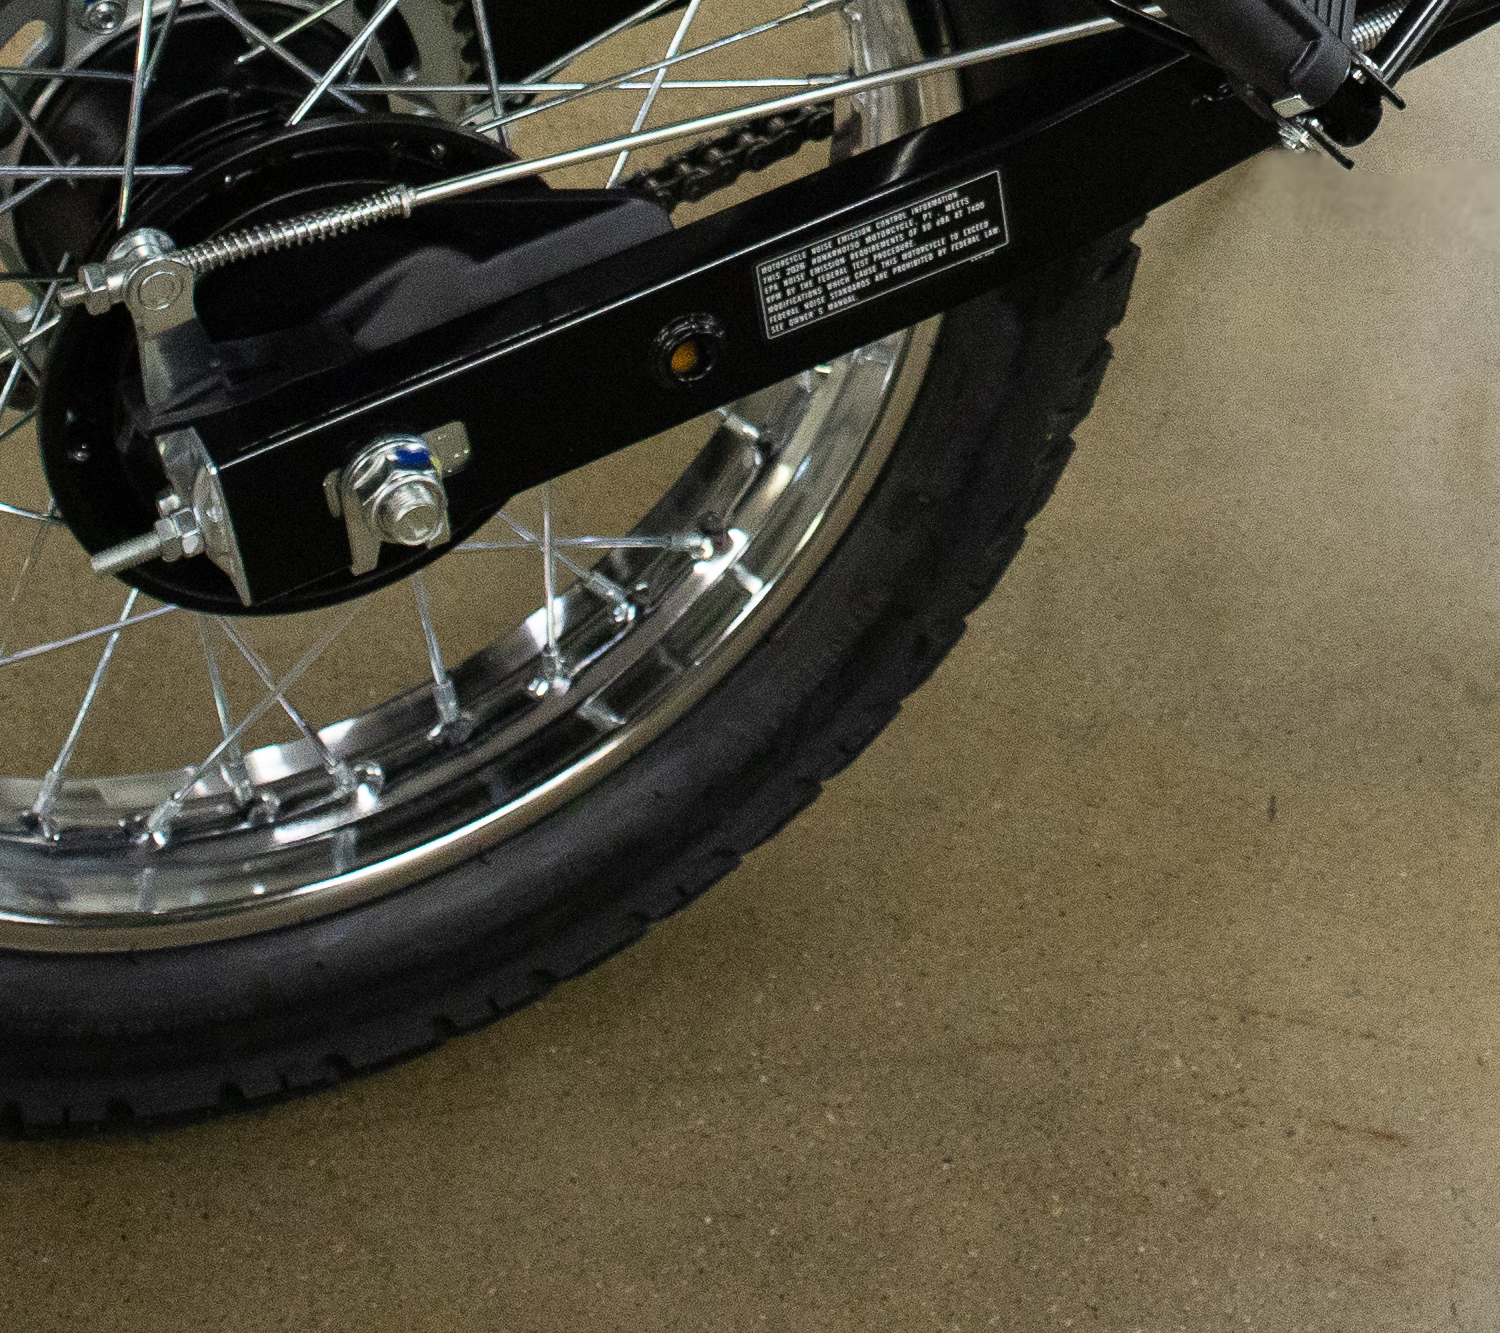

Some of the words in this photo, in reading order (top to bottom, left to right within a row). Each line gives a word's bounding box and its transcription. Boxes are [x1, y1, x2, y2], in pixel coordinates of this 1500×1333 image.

[761, 251, 806, 274] MOTORCYCLE
[811, 241, 832, 255] NOISE
[837, 225, 871, 244] EMISSION
[875, 212, 906, 229] CONTROL
[911, 191, 958, 215] INFORMATION
[762, 271, 780, 284] THIS
[945, 197, 969, 213] MEETS
[763, 283, 778, 294] EPA
[783, 272, 805, 287] NOISE
[809, 256, 845, 276] EMISSION
[849, 233, 904, 260] REQUIREMENTS
[908, 228, 917, 237] OF
[954, 210, 962, 219] AT
[767, 286, 822, 314] MODIFICATIONS
[826, 275, 850, 290] WHICH
[854, 265, 876, 279] CAUSE
[881, 257, 897, 269] THIS
[901, 238, 945, 261] MOTORCYCLE
[950, 232, 958, 241] TO
[963, 220, 988, 236] EXCEED
[765, 292, 782, 304] RPM
[786, 286, 795, 296] BY
[800, 280, 813, 290] THE
[817, 266, 847, 283] FEDERAL
[852, 258, 868, 270] TEST
[769, 306, 799, 324] FEDERAL
[804, 296, 825, 310] NOISE
[829, 278, 870, 299] STANDARDS
[874, 271, 887, 282] ARE
[892, 253, 933, 275] PROHIBITED
[937, 247, 946, 257] BY
[950, 234, 979, 251] FEDERAL
[770, 322, 783, 333] SEE
